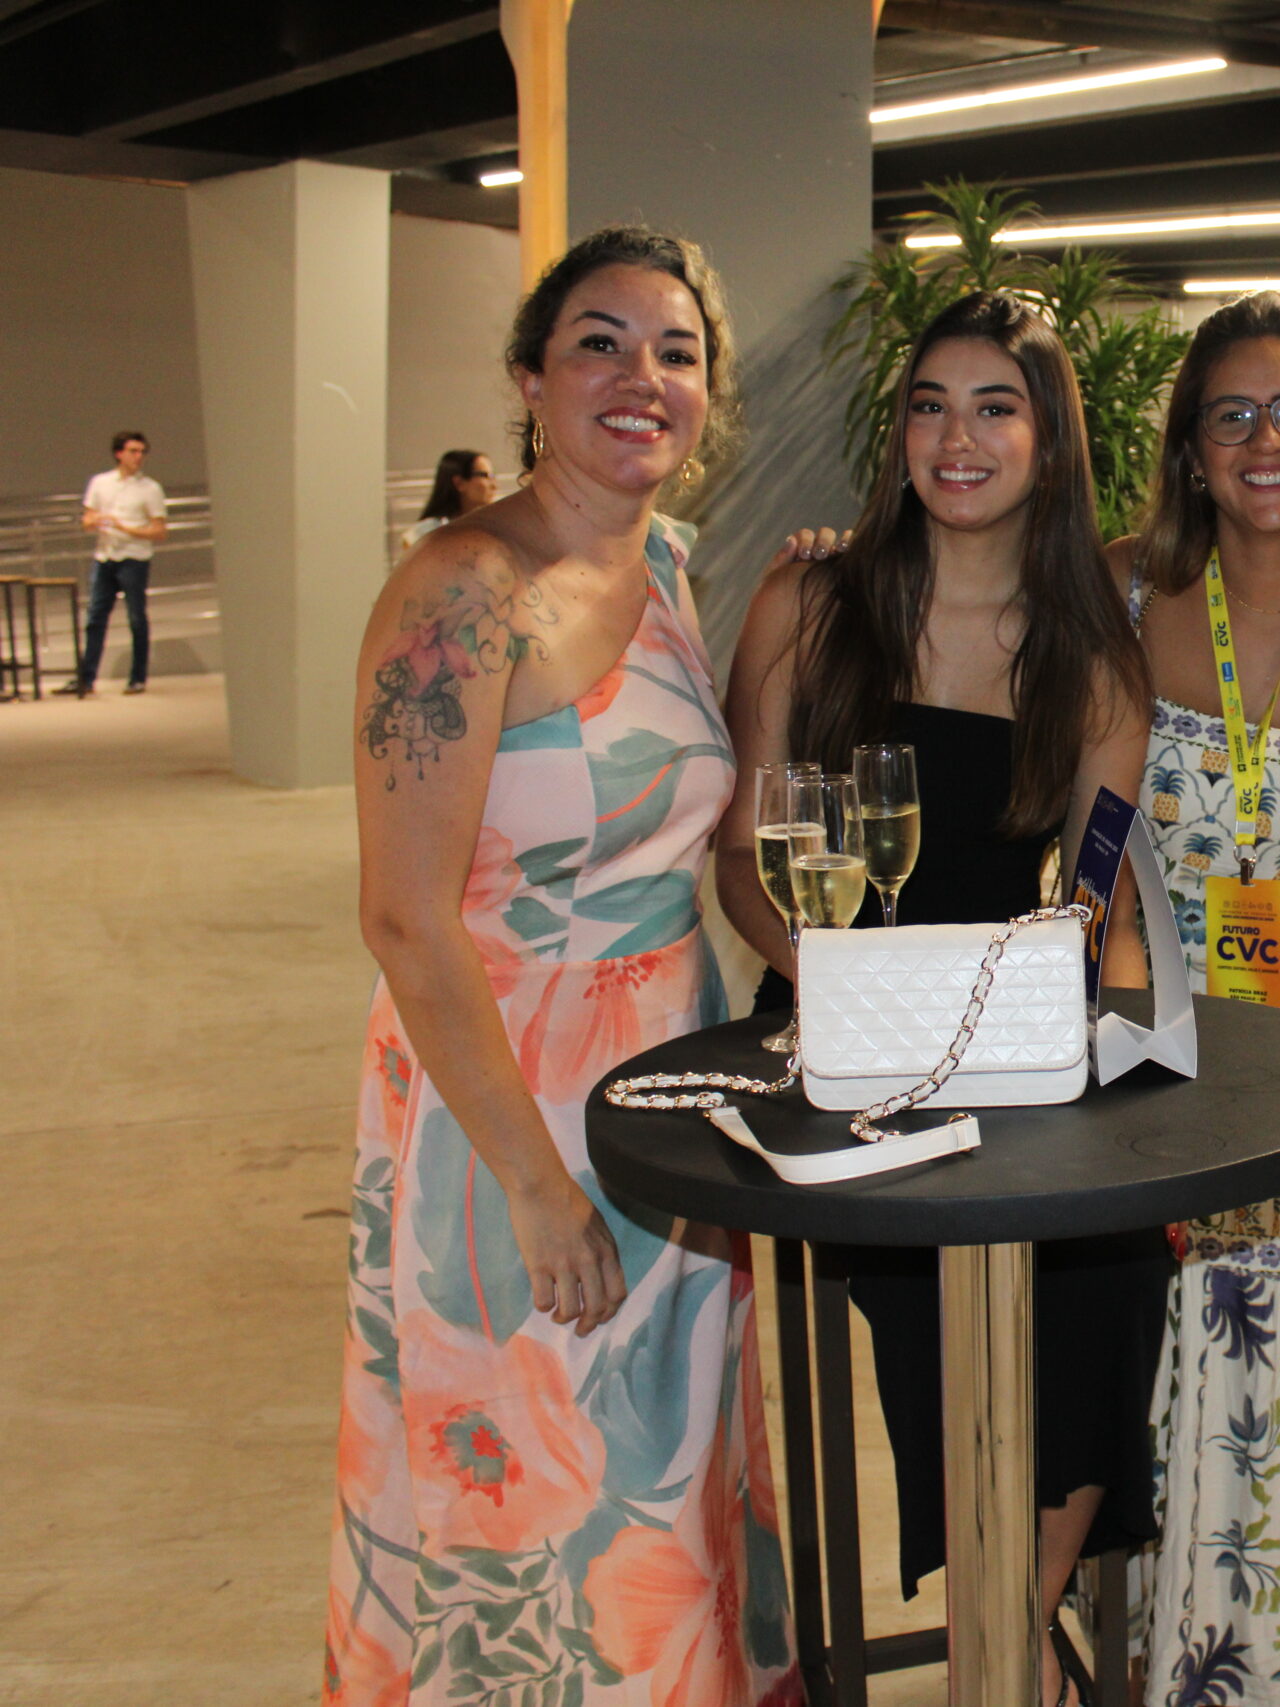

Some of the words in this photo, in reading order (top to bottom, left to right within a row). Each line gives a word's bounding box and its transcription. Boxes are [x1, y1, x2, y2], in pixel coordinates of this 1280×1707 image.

[1217, 621, 1229, 647] CVC
[1243, 788, 1253, 815] CVC
[1222, 925, 1260, 936] FUTURO
[1216, 935, 1280, 965] CVC
